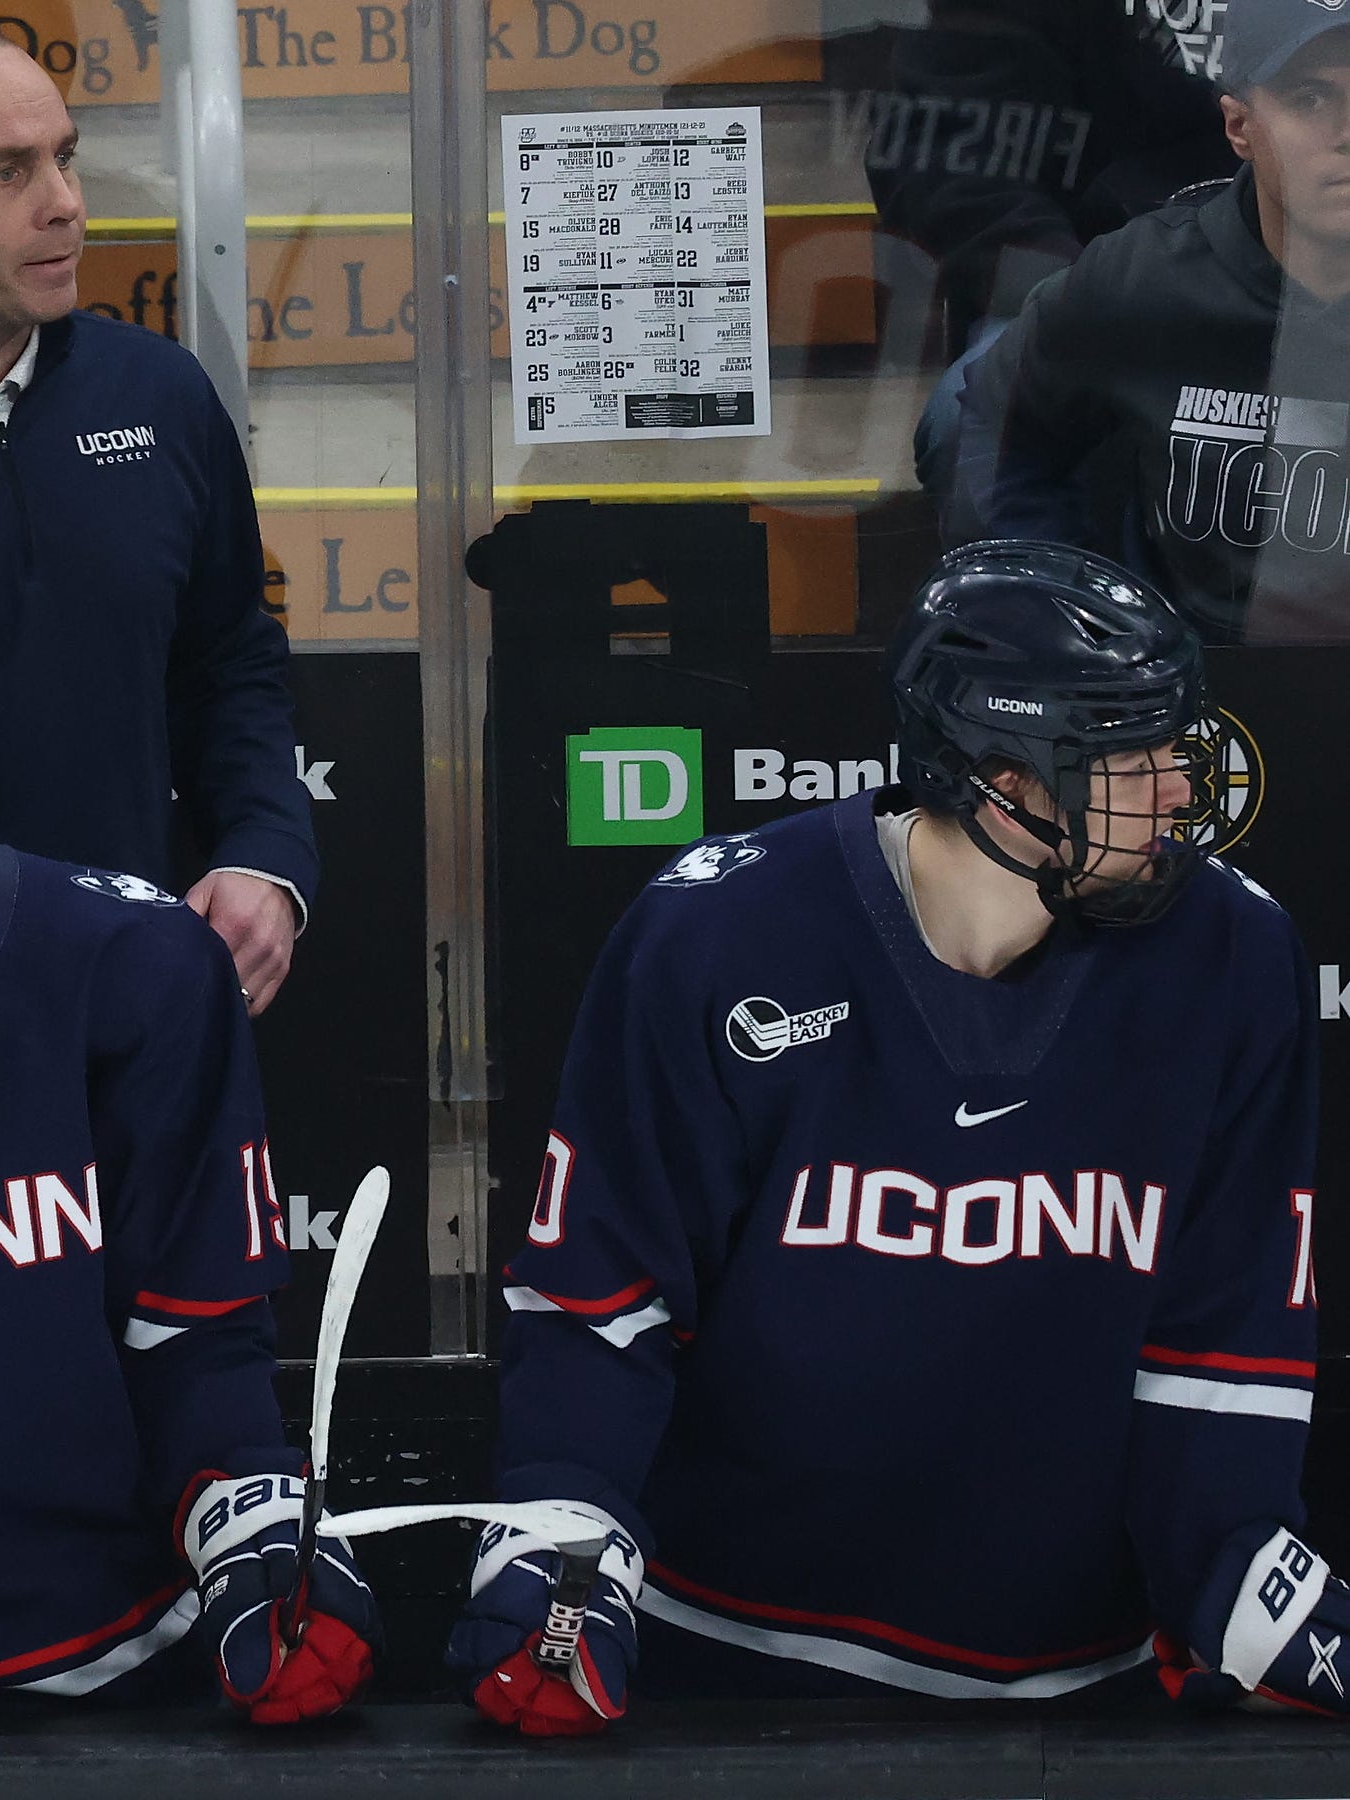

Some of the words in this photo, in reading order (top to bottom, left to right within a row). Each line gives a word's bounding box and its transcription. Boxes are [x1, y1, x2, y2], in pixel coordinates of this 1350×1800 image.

[237, 7, 337, 68] The
[533, 0, 661, 76] Dog
[520, 154, 530, 171] 8
[596, 151, 613, 168] 10
[673, 149, 690, 167] 12
[521, 187, 530, 204] 7
[597, 184, 618, 201] 27
[674, 182, 691, 200] 13
[522, 221, 539, 238] 15
[599, 218, 620, 236] 28
[675, 216, 693, 234] 14
[523, 255, 540, 272] 19
[600, 252, 612, 269] 11
[676, 250, 698, 268] 22
[526, 295, 537, 313] 4
[602, 293, 612, 310] 6
[678, 290, 694, 307] 31
[526, 329, 546, 347] 23
[602, 326, 612, 344] 3
[679, 324, 685, 342] 1
[528, 364, 549, 382] 25
[604, 361, 625, 379] 26
[680, 360, 700, 377] 32
[545, 397, 555, 414] 5
[1175, 386, 1279, 428] HUSKIES
[75, 425, 156, 455] UCONN
[96, 451, 151, 466] HOCKEY
[1167, 435, 1350, 555] UCO
[988, 696, 1043, 716] UCONN
[579, 749, 689, 822] TD
[790, 1005, 846, 1030] HOCKEY
[790, 1023, 827, 1043] EAST
[780, 1161, 1166, 1274] UCONN
